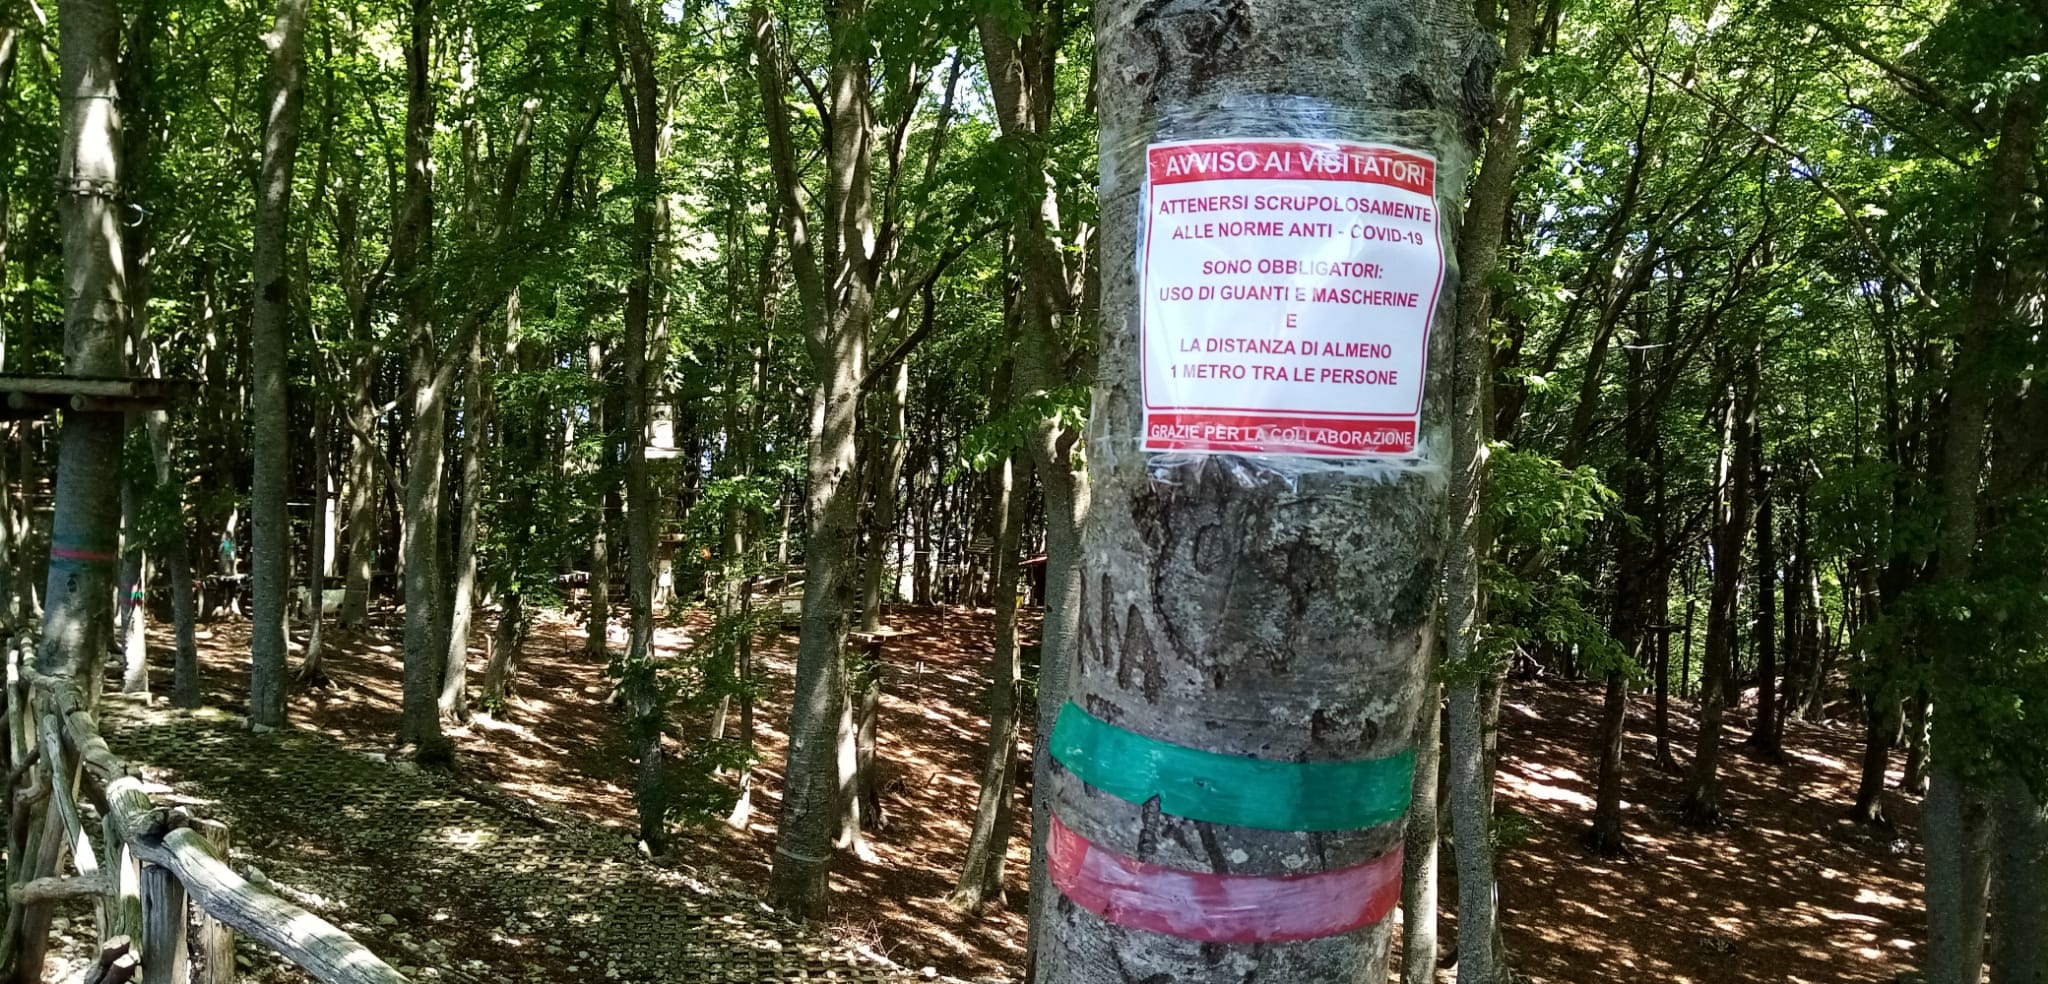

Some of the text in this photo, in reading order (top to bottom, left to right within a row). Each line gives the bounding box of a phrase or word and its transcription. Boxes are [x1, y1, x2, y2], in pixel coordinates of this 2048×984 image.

[1165, 150, 1426, 187] AVVISO AI VISITATORI
[1159, 195, 1432, 223] ATTENERSI SCRUPOLOSAMENTE
[1172, 224, 1213, 240] ALLE
[1218, 222, 1284, 237] NORME
[1289, 223, 1332, 238] ANTI
[1350, 224, 1424, 246] COVID-19
[1202, 258, 1384, 279] SONO OBBLIGATORI:
[1159, 285, 1420, 308] USO DI GUANTI E MASCHERINE
[1286, 313, 1297, 329] E
[1180, 338, 1392, 359] LA DISTANZA DI ALMENO
[1170, 364, 1398, 386] 1 METRO TRA LE PERSONE
[1151, 424, 1413, 446] GRAZIE PER LA COLLABORAZIONE
